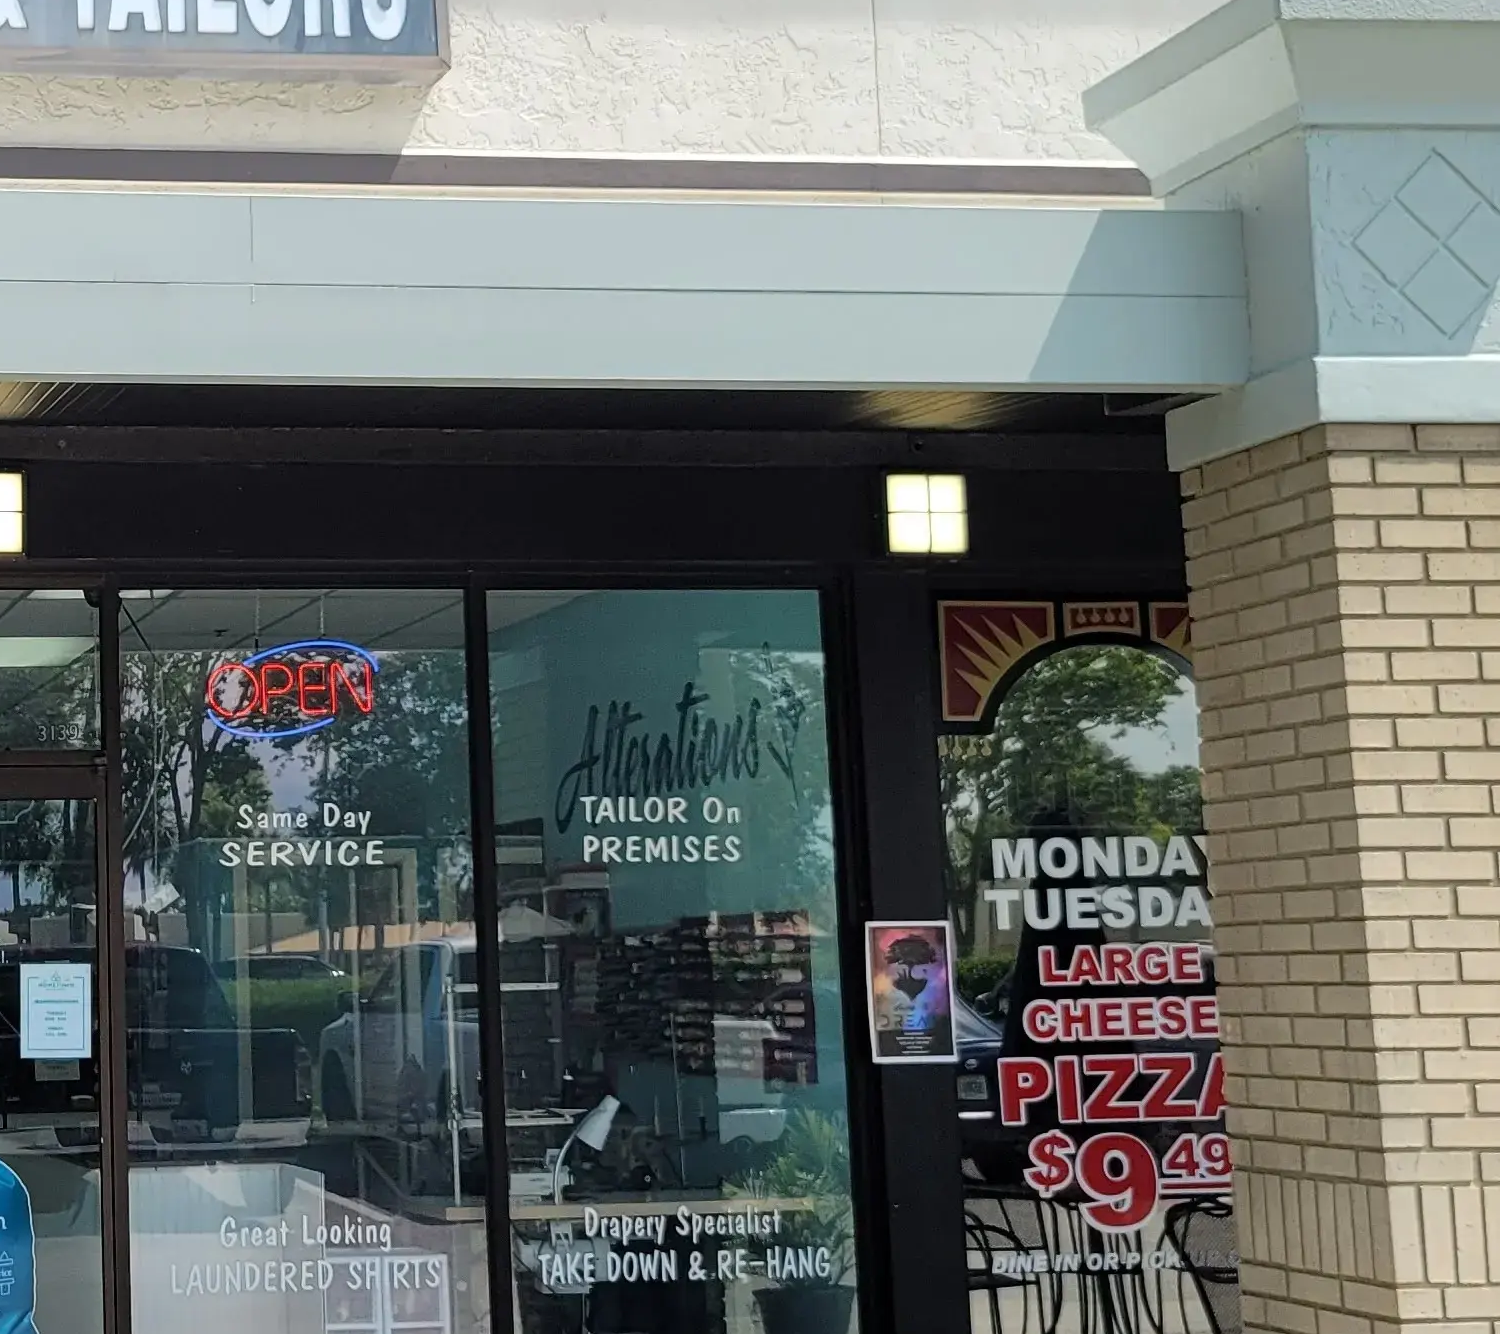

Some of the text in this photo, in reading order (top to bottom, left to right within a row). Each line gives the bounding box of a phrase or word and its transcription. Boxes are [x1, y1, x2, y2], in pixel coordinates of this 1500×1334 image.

[206, 661, 375, 717] OPEN
[37, 724, 79, 742] 3139
[237, 802, 371, 835] Same Day
[580, 796, 740, 824] TAILOR On
[218, 840, 385, 867] SERVICE
[583, 835, 742, 863] PREMISES
[991, 835, 1208, 879] MONDA
[983, 884, 1215, 931] TUESDA
[1038, 945, 1204, 986] LARGE
[1023, 996, 1219, 1042] CHEESE
[220, 1215, 392, 1252] Great Looking
[583, 1204, 782, 1246] Drapery Specialist
[170, 1259, 441, 1296] LAUNDERED SHRTS
[538, 1246, 831, 1285] TAKE DOWN & RE-HANG
[991, 1250, 1049, 1273] DINE
[1053, 1252, 1080, 1272] IN
[1086, 1252, 1120, 1272] OR
[1124, 1250, 1184, 1270] PCK
